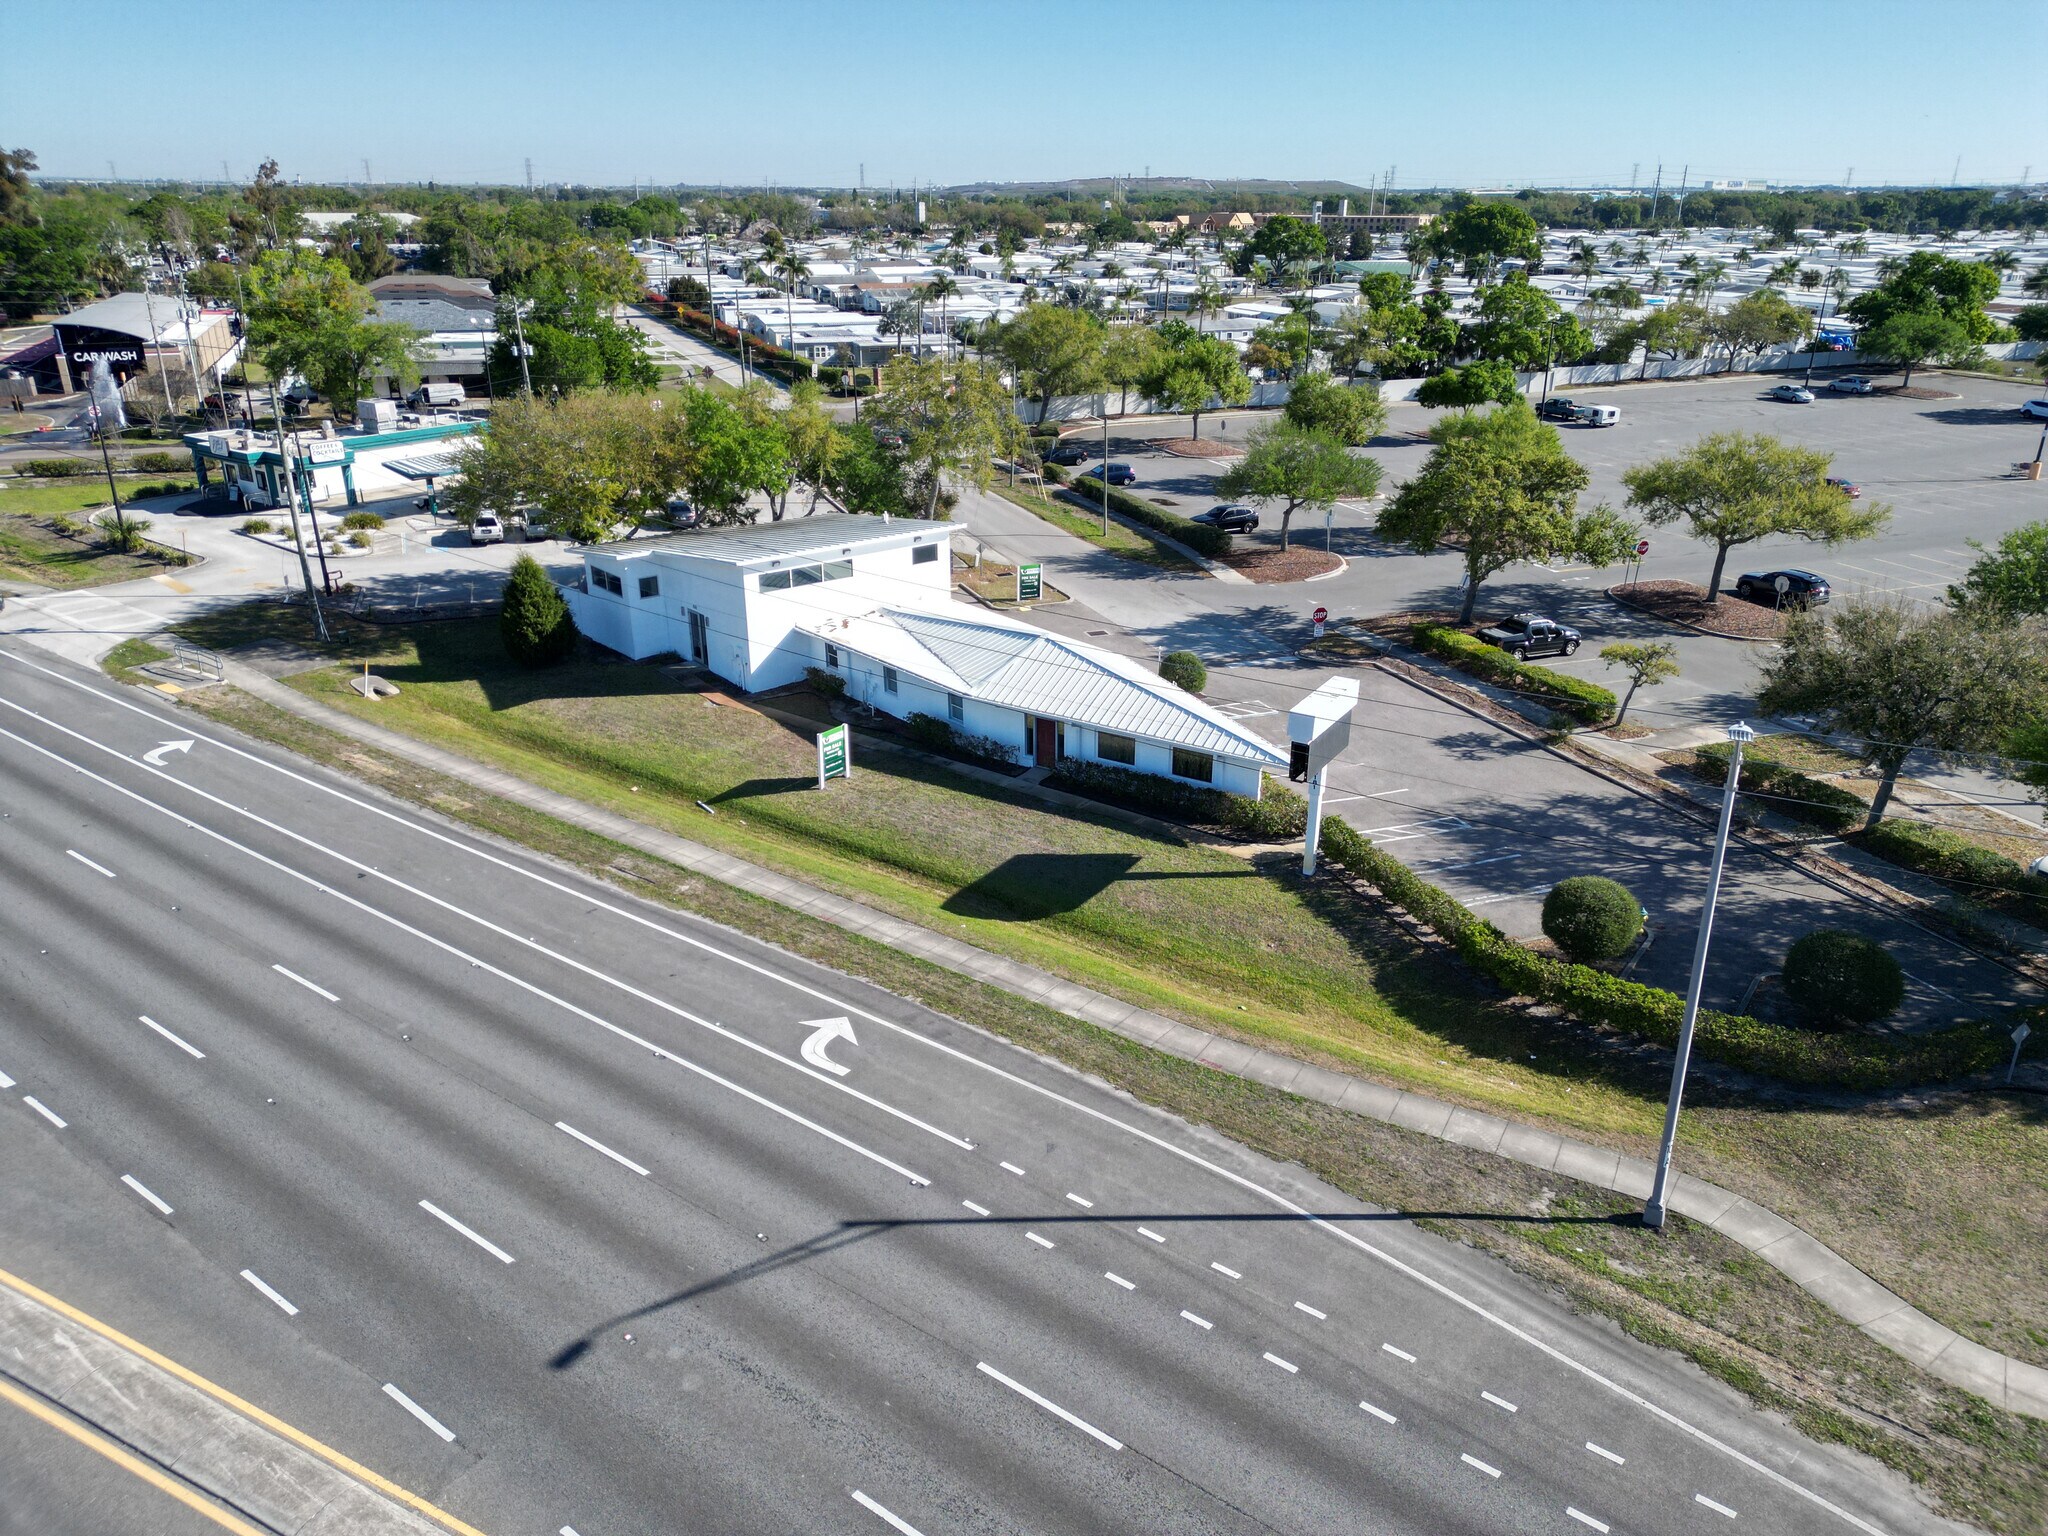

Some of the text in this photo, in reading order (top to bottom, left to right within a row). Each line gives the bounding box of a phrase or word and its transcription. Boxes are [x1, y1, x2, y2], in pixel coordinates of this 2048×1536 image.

[73, 350, 138, 362] CAR WASH
[1313, 611, 1327, 619] STOP
